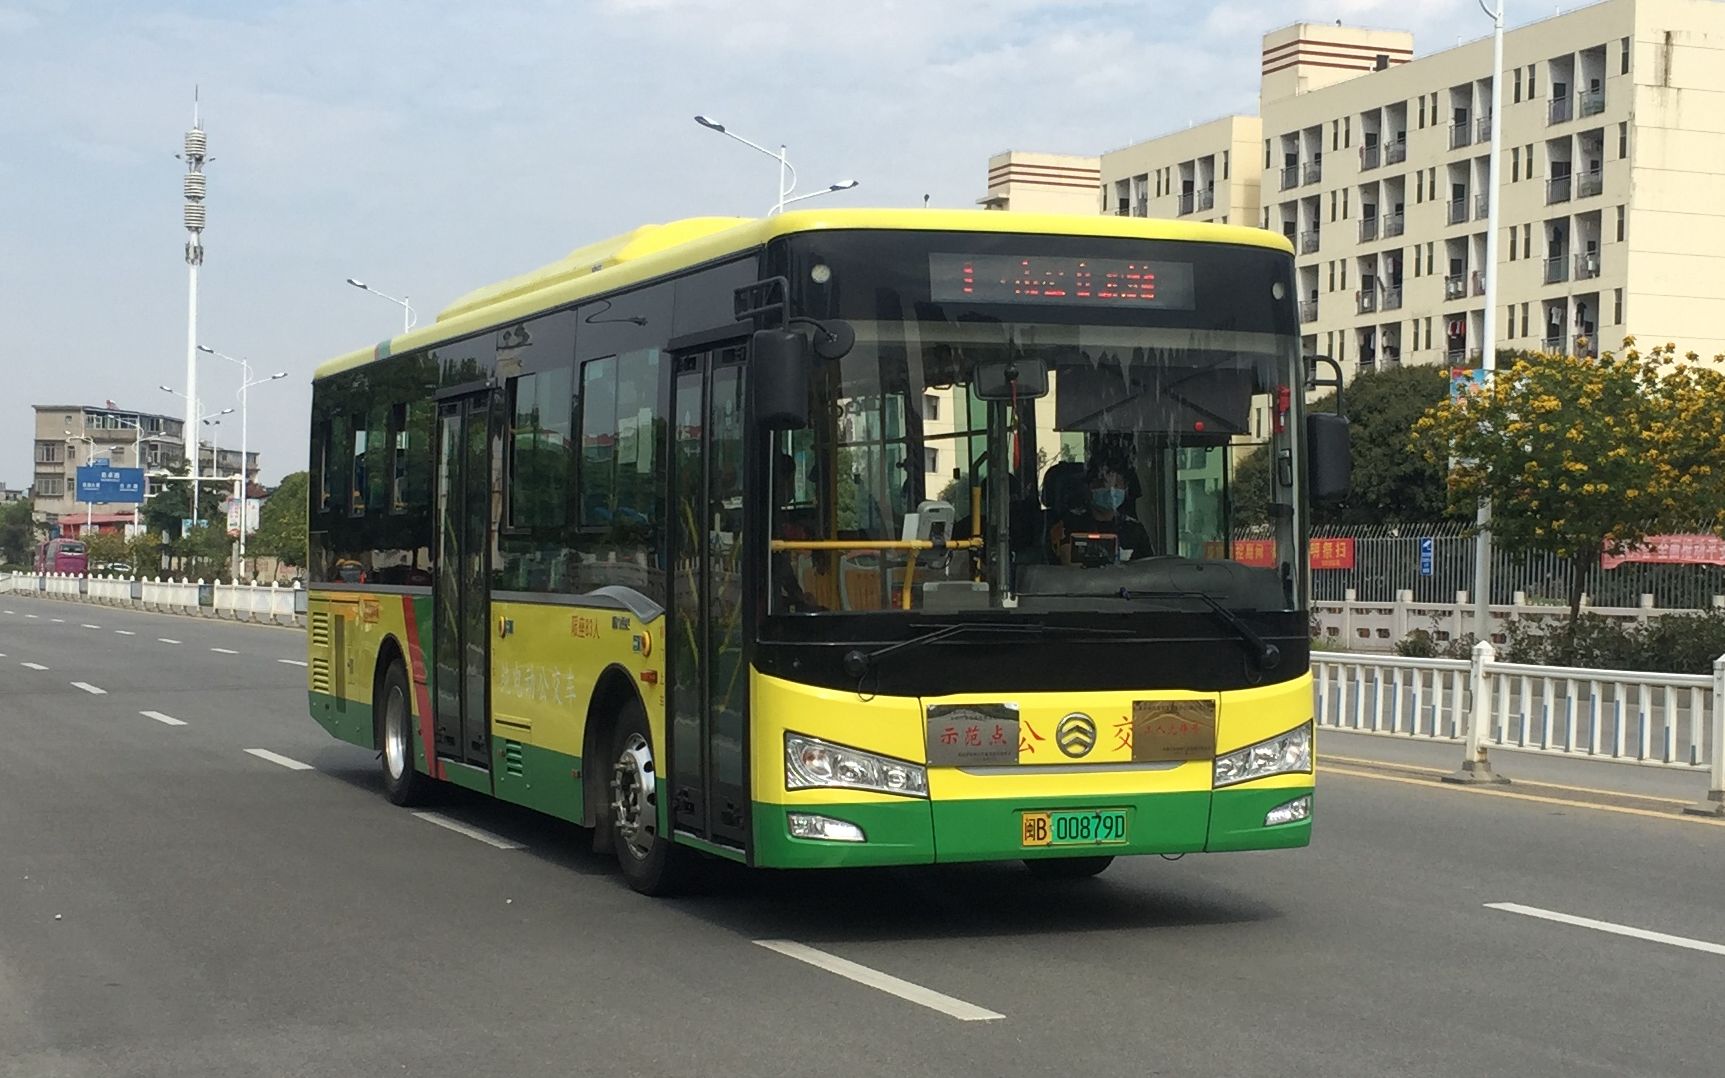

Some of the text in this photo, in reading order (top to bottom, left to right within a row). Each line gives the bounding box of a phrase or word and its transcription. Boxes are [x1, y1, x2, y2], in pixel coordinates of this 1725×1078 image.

[941, 724, 1007, 747] 示范点
[1112, 715, 1133, 752] 交
[1056, 815, 1125, 840] 00879D
